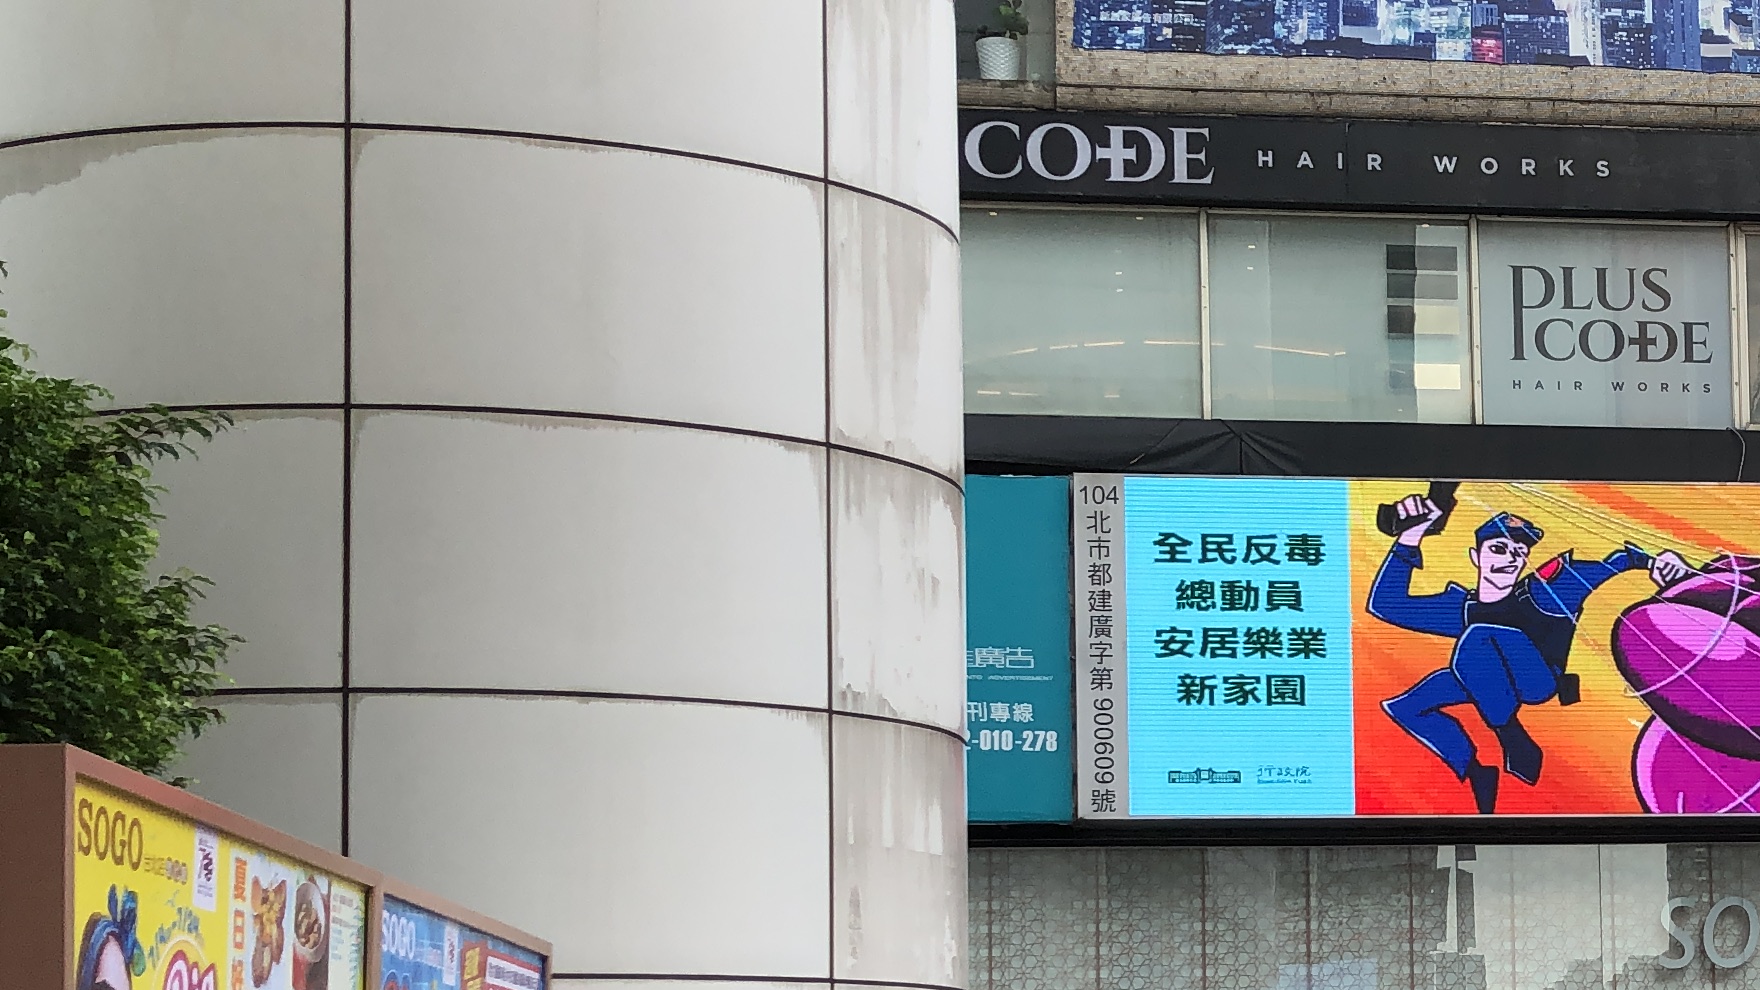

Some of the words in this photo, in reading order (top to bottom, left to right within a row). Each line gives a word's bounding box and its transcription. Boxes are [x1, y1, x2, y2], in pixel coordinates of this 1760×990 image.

[964, 121, 1214, 184] CODE
[1257, 149, 1382, 172] HAIR
[1433, 154, 1610, 179] WORKS
[1512, 379, 1583, 391] HAIR
[1611, 380, 1711, 394] WORKS
[1152, 531, 1327, 567] 全民反毒
[1175, 578, 1305, 613] 總動員
[1154, 625, 1328, 660] 安居樂業
[1177, 672, 1307, 707] 新家園
[77, 797, 144, 872] SOGO
[382, 909, 417, 961] SOGO
[1658, 894, 1760, 969] SO
